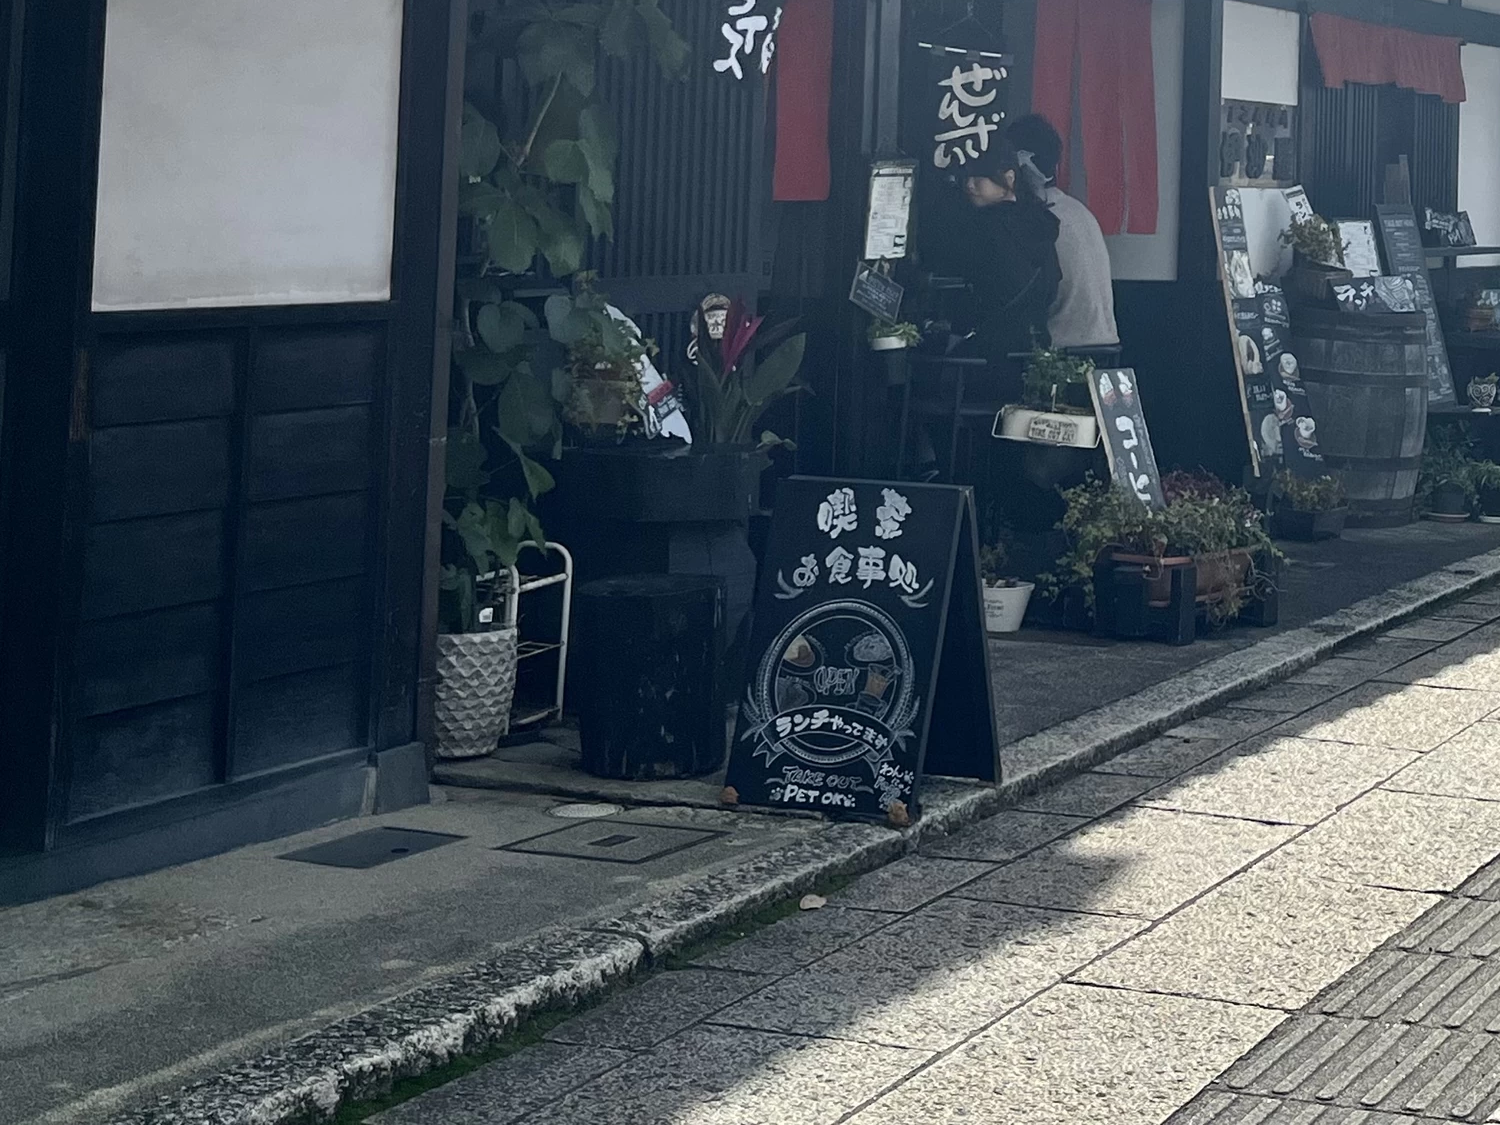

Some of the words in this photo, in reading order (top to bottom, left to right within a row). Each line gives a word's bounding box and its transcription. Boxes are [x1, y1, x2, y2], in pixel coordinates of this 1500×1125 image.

[932, 61, 1008, 169] ぜんざい
[816, 486, 913, 540] 喫茶
[793, 544, 920, 594] お食事処
[813, 665, 860, 696] OPEN
[775, 708, 890, 750] ランチやってます
[782, 765, 826, 787] TAKE
[826, 774, 863, 790] OUT
[783, 783, 820, 803] PET
[821, 791, 845, 806] OK
